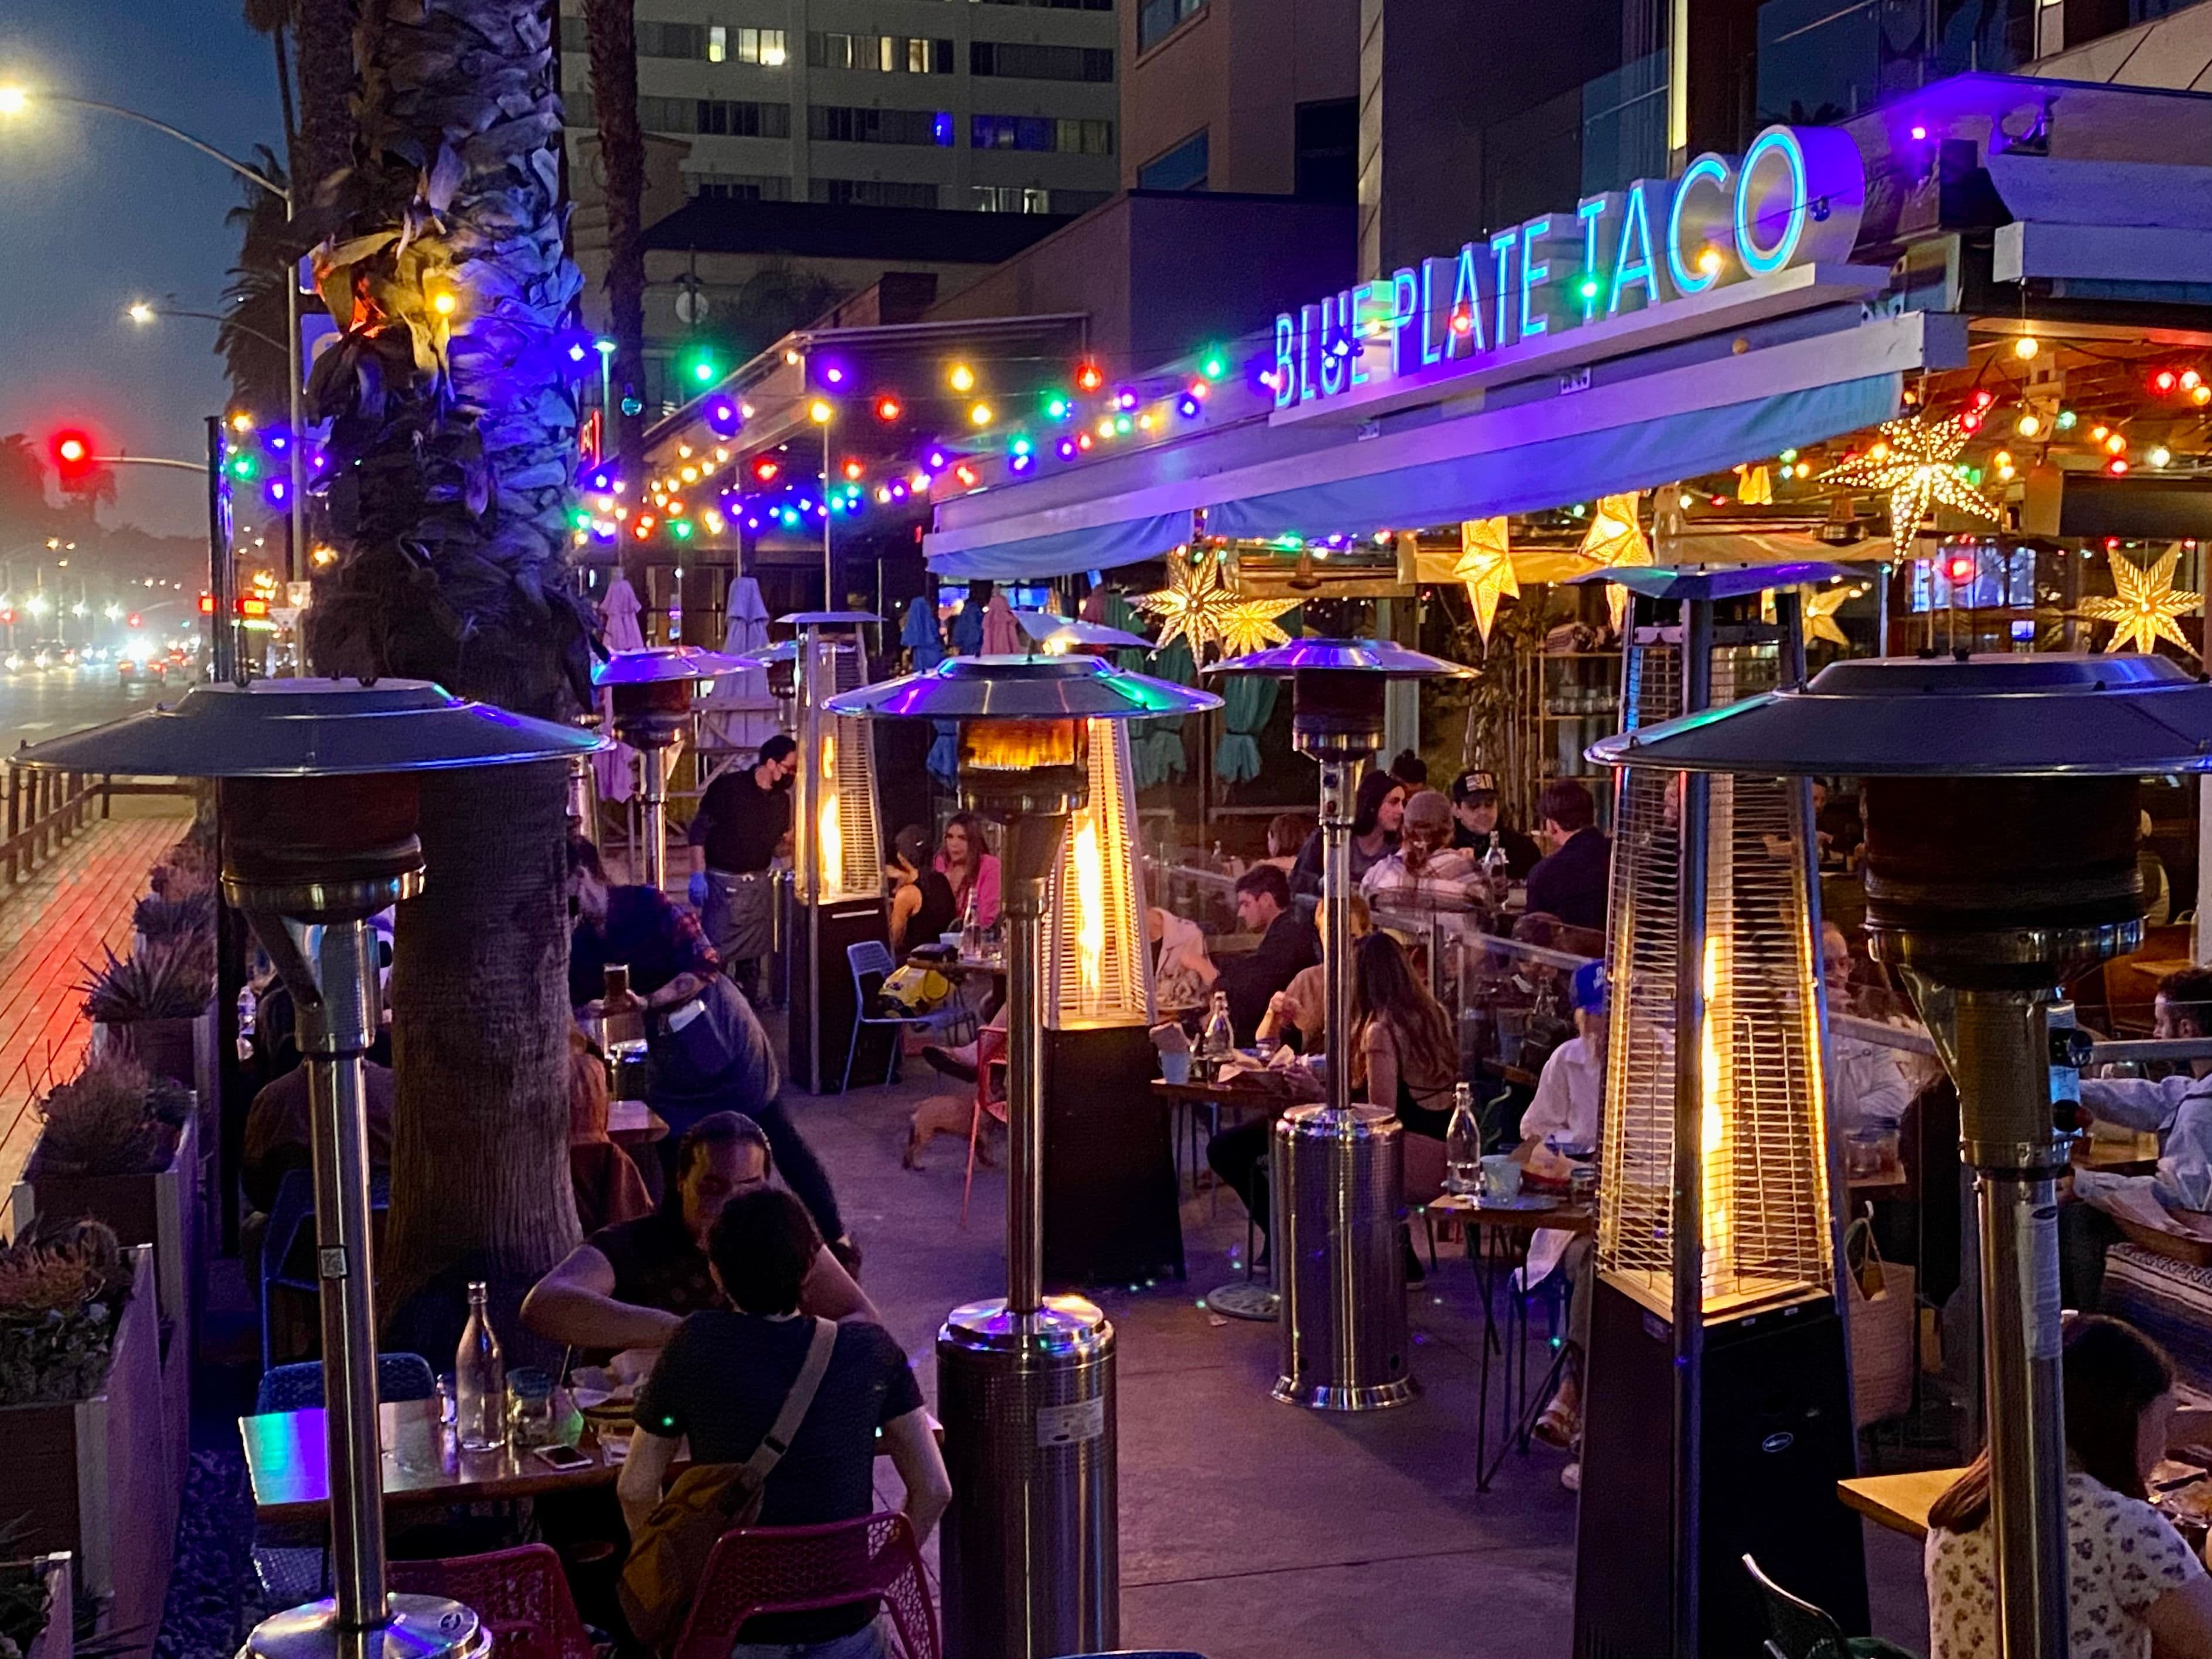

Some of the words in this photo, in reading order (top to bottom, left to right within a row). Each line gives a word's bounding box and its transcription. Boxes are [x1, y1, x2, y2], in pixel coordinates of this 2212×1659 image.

[1274, 284, 1373, 409] BLUE
[1391, 218, 1550, 374] PLATE
[1577, 125, 1807, 320] TACO
